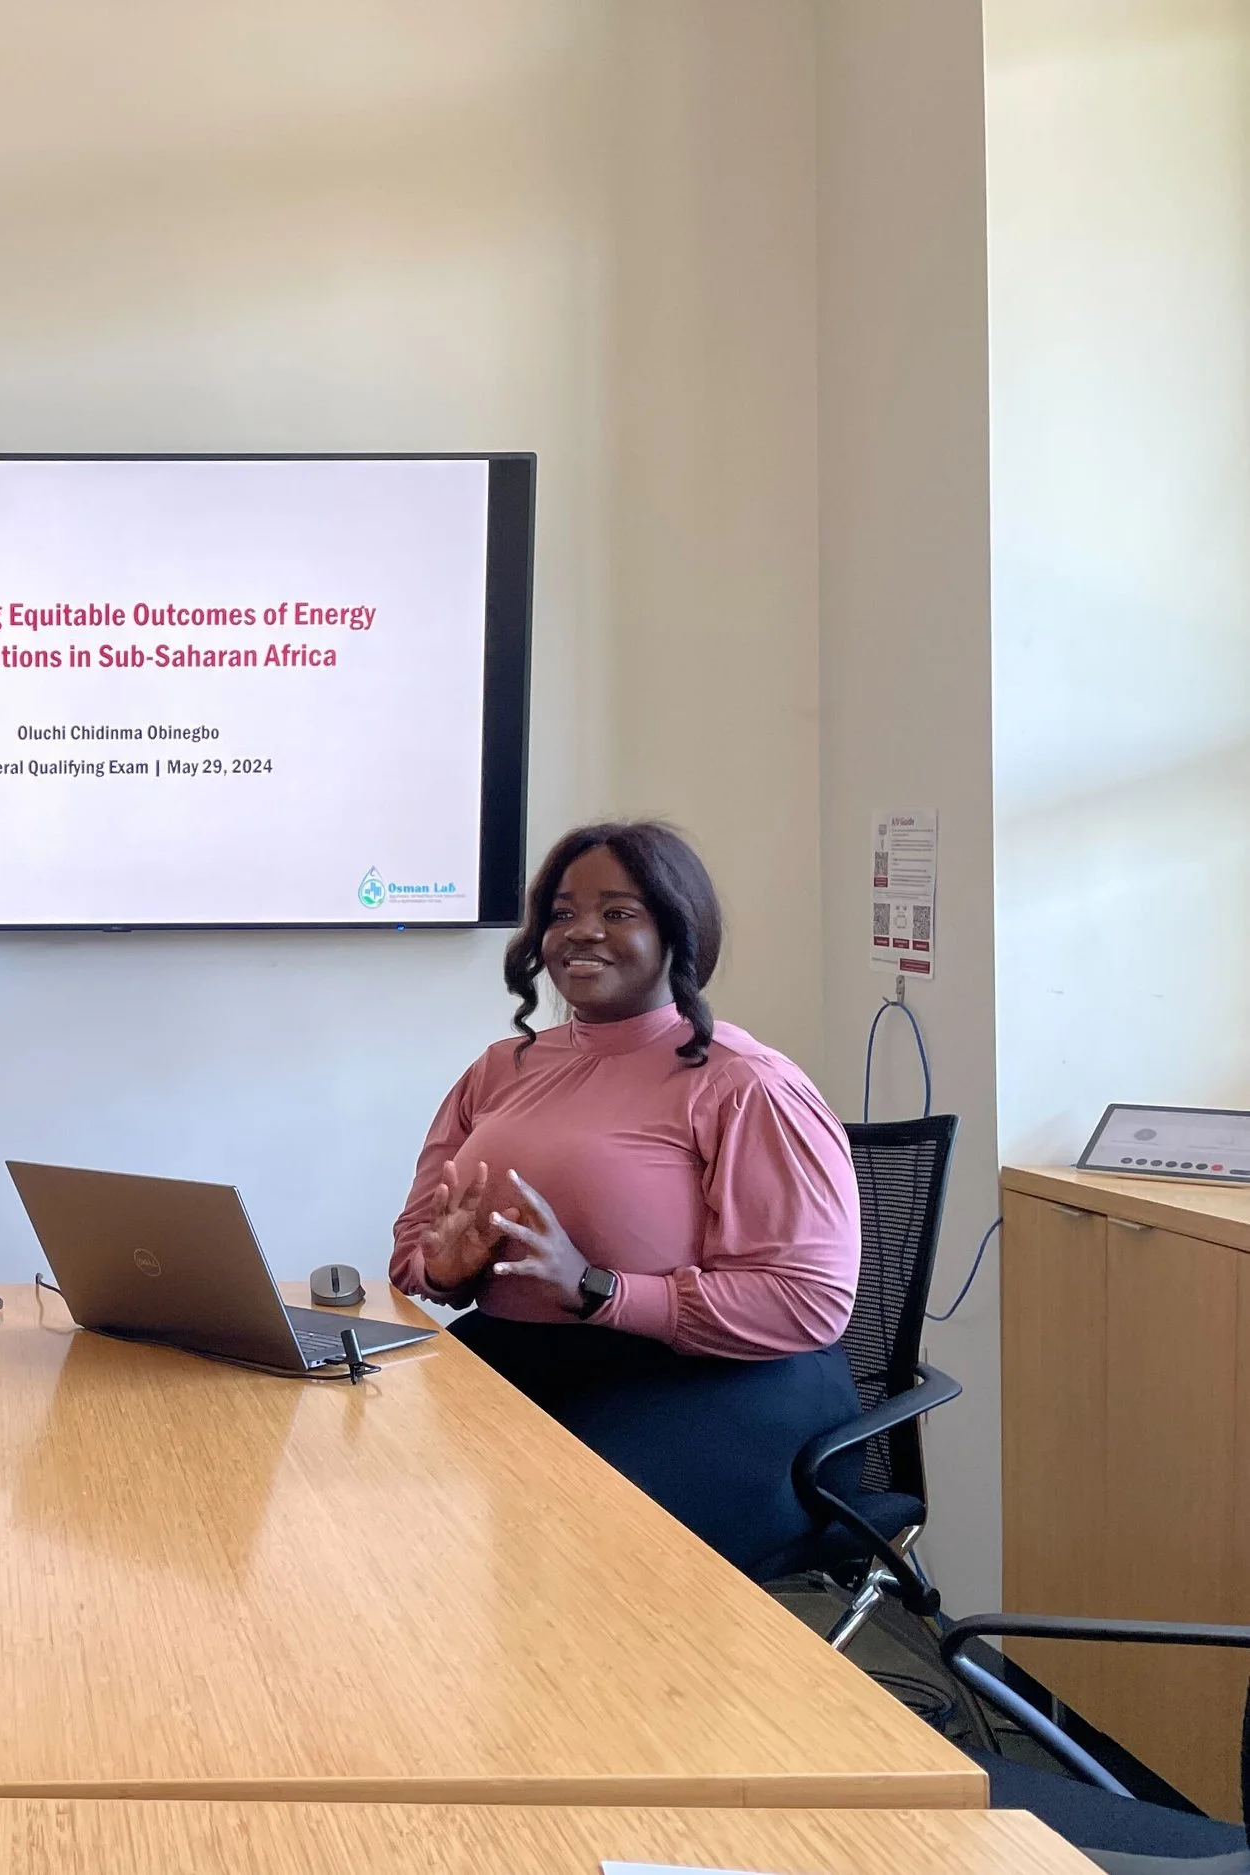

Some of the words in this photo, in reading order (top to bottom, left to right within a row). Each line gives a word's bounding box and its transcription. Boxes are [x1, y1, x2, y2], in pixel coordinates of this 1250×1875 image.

[9, 602, 126, 632] Equitable
[133, 602, 257, 627] Outcomes
[263, 601, 288, 626] of
[294, 602, 377, 631] Energy
[69, 644, 92, 668] in
[98, 644, 258, 668] Sub-Saharan
[263, 643, 337, 668] Africa
[17, 725, 66, 741] Oluchi
[70, 725, 143, 741] Chidinma
[147, 724, 220, 743] Obinegbo
[28, 759, 106, 778] Qualifying
[109, 759, 149, 775] Exam
[167, 759, 199, 777] May
[202, 758, 228, 777] 29,
[231, 758, 273, 774] 2024
[388, 882, 430, 893] Osman
[434, 882, 456, 893] Lab
